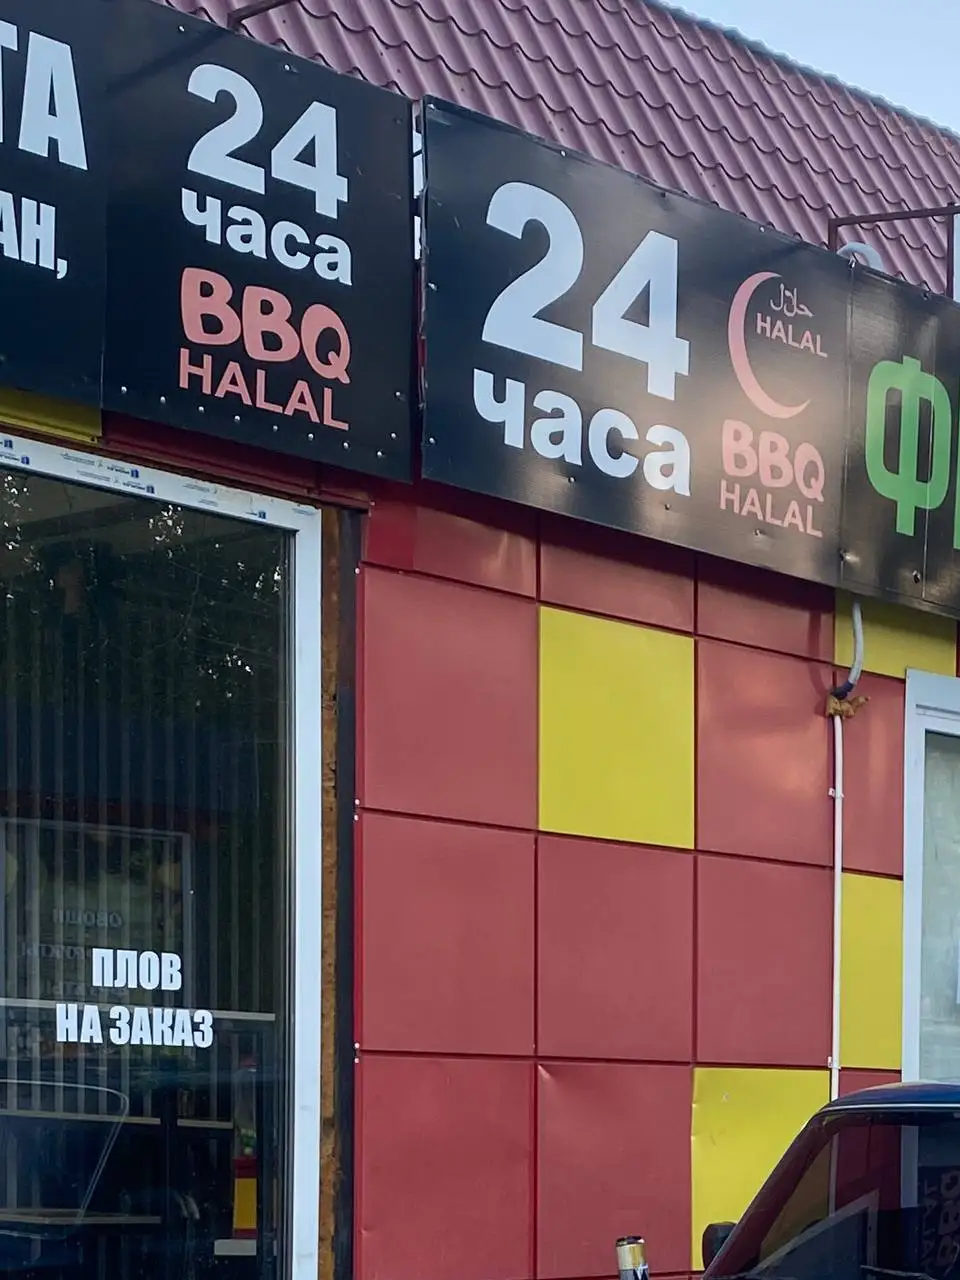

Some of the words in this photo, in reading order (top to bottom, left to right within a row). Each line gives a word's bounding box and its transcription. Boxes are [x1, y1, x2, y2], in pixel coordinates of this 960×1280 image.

[187, 63, 348, 219] 24
[181, 187, 352, 286] часа
[180, 267, 350, 384] BBQ
[481, 182, 690, 401] 24
[770, 283, 815, 317] حلال
[757, 312, 828, 358] HALAL
[179, 347, 349, 431] HALAL
[473, 368, 691, 496] часа
[722, 419, 825, 502] BBQ
[720, 481, 823, 538] HALAL
[92, 948, 182, 991] ПЛОВ
[56, 1003, 103, 1044] НА
[109, 1005, 213, 1049] ЗАКАЗ
